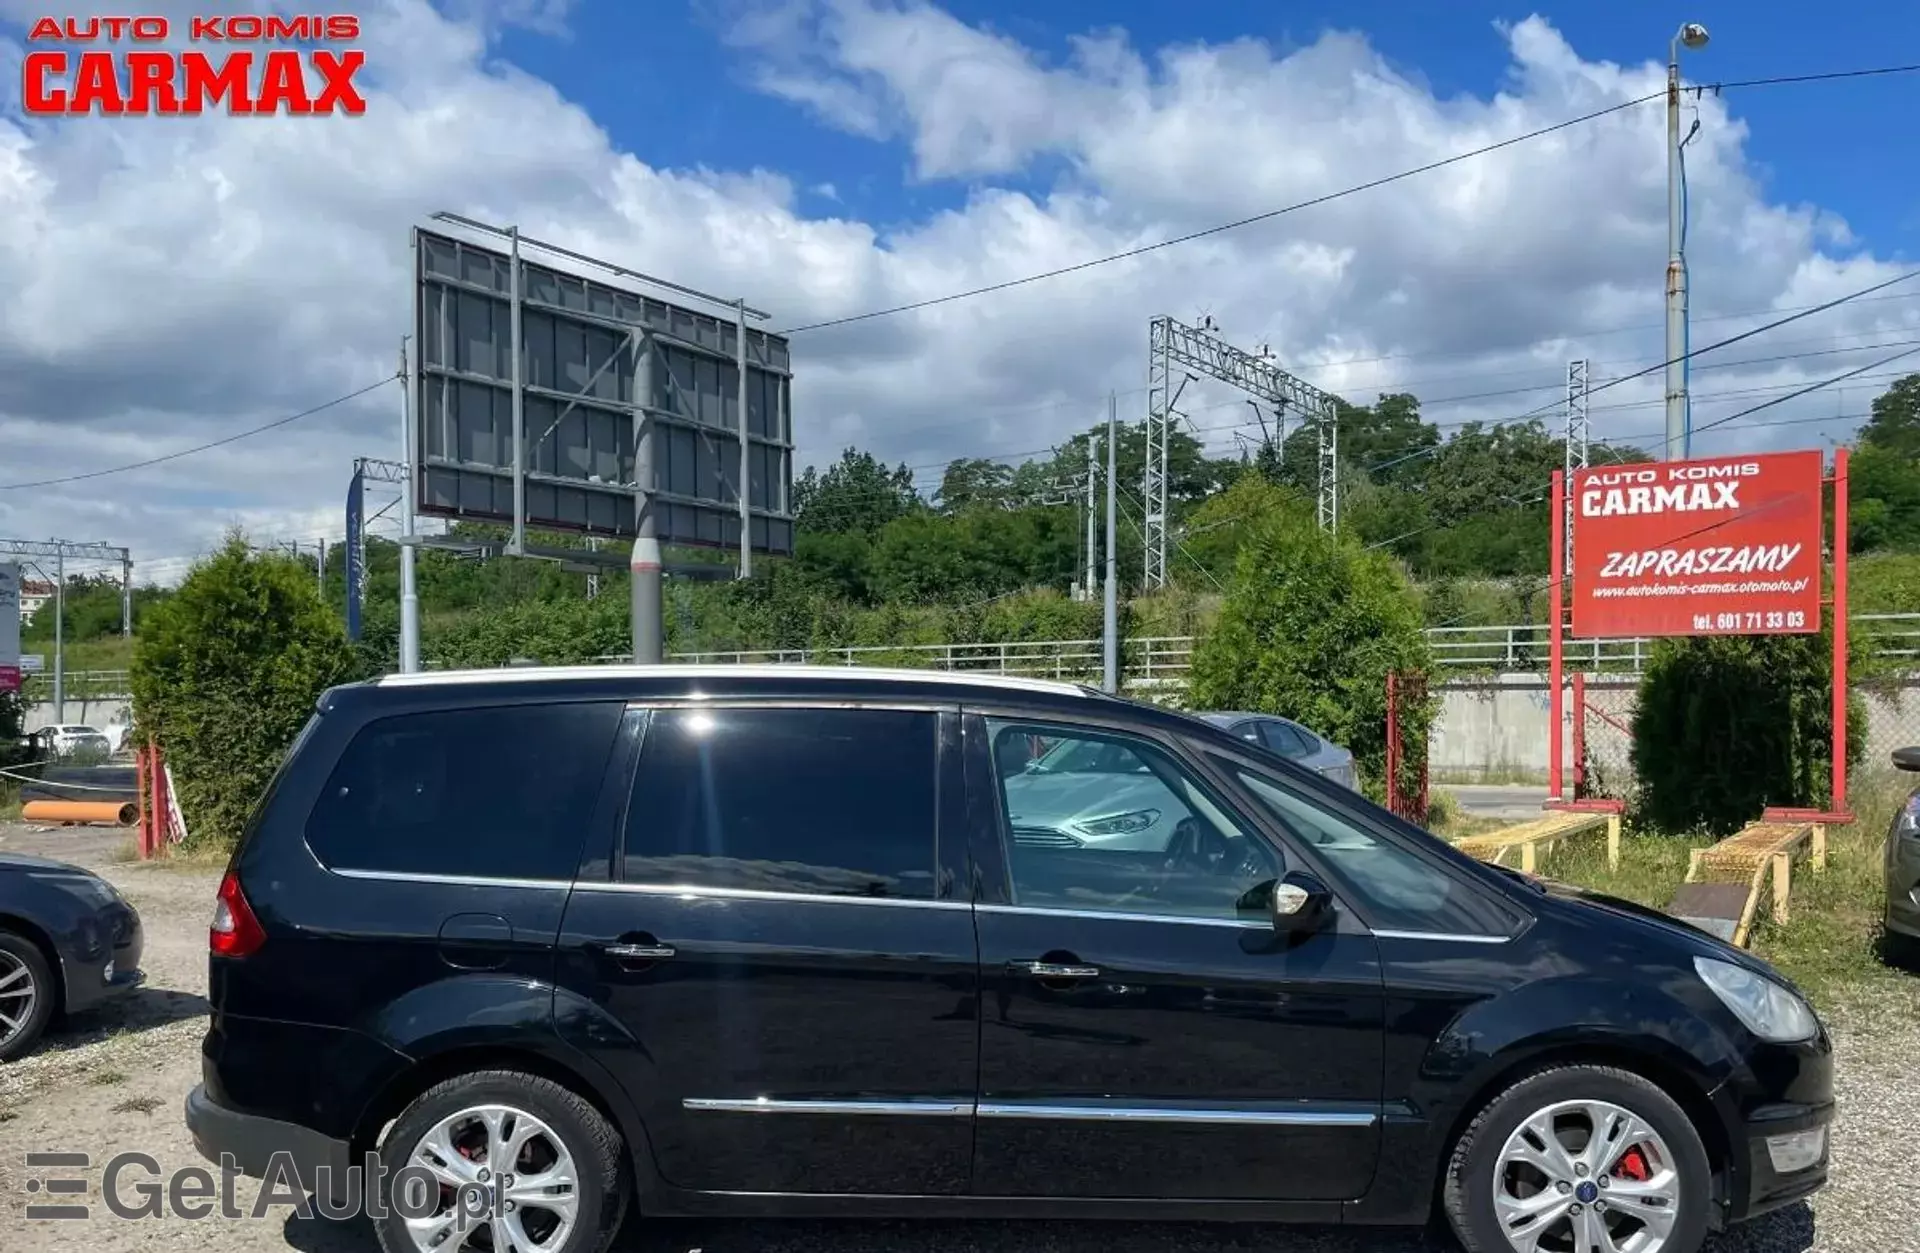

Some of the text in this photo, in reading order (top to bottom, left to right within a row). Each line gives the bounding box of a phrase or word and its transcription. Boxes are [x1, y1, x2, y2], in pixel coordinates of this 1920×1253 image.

[1583, 463, 1760, 486] AUTO KOMIS
[1582, 481, 1739, 517] CARMAX
[1600, 543, 1801, 577] ZAPRASZAMY
[1593, 577, 1809, 598] www.autokomis-carmax.otomoto.pl
[1693, 611, 1805, 630] tel. 601 71 33 03
